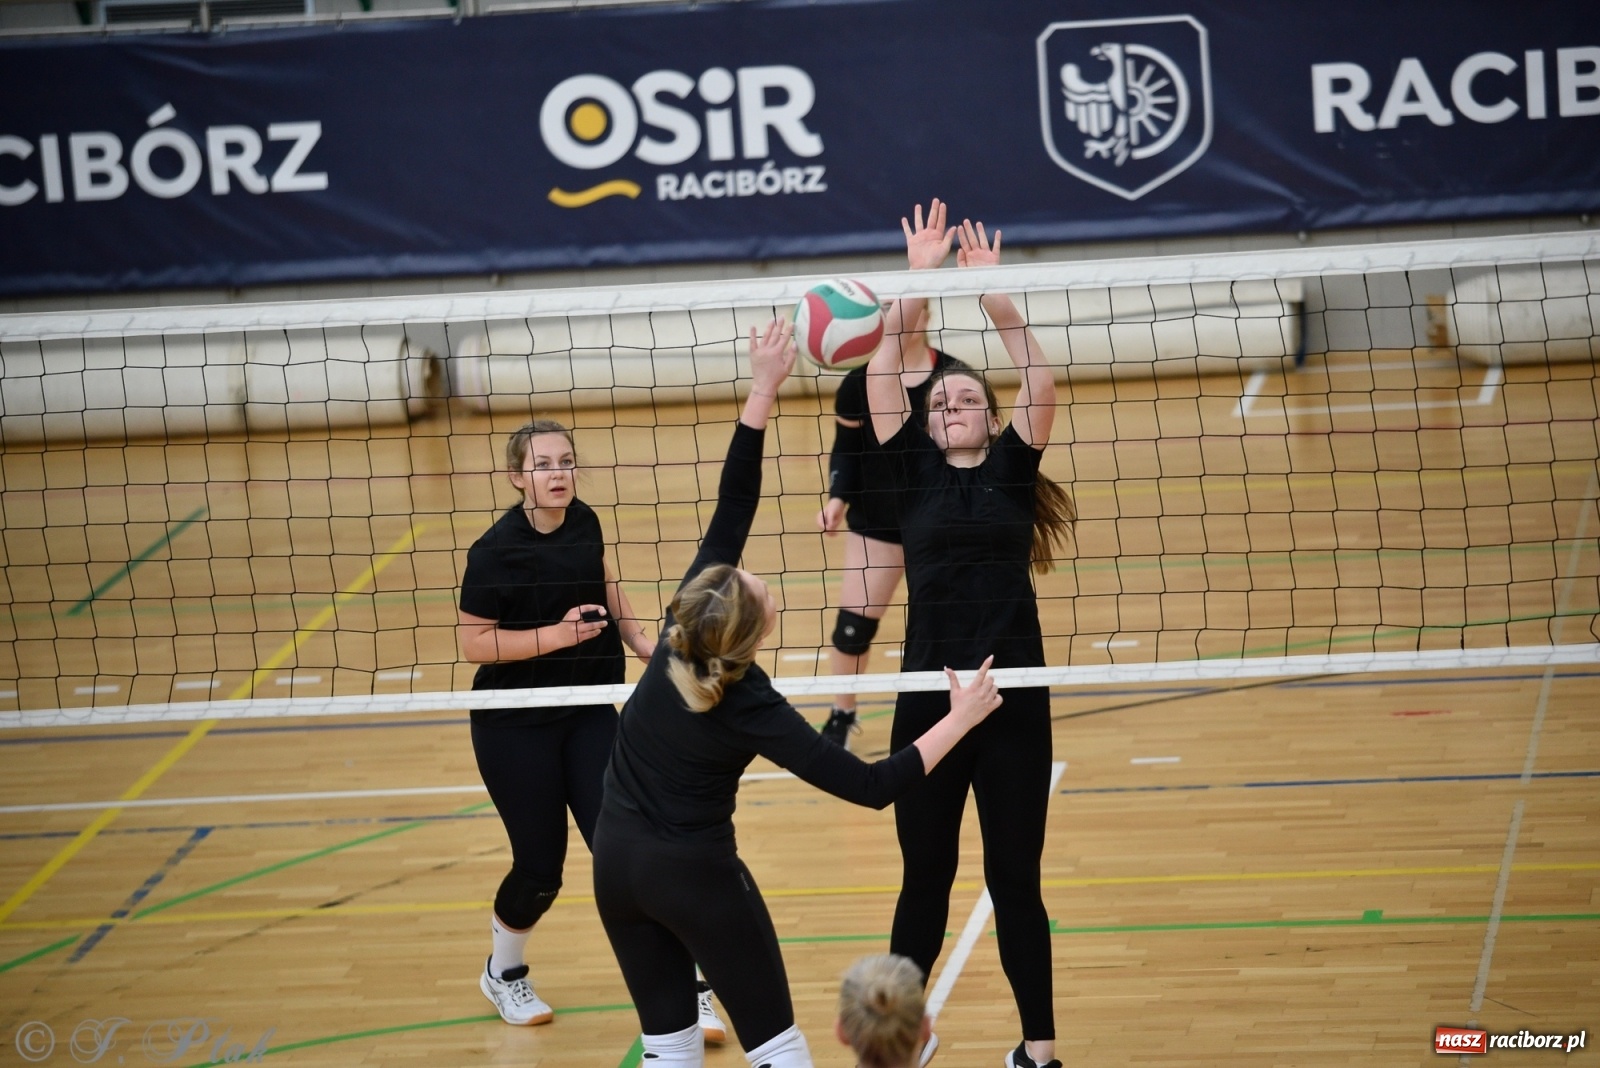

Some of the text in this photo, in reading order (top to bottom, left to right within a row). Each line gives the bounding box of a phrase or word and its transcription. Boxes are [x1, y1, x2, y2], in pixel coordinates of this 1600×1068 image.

[1311, 46, 1600, 134] RACIB
[0, 101, 329, 206] CIBÓRZ
[656, 160, 827, 201] RACIBÓRZ
